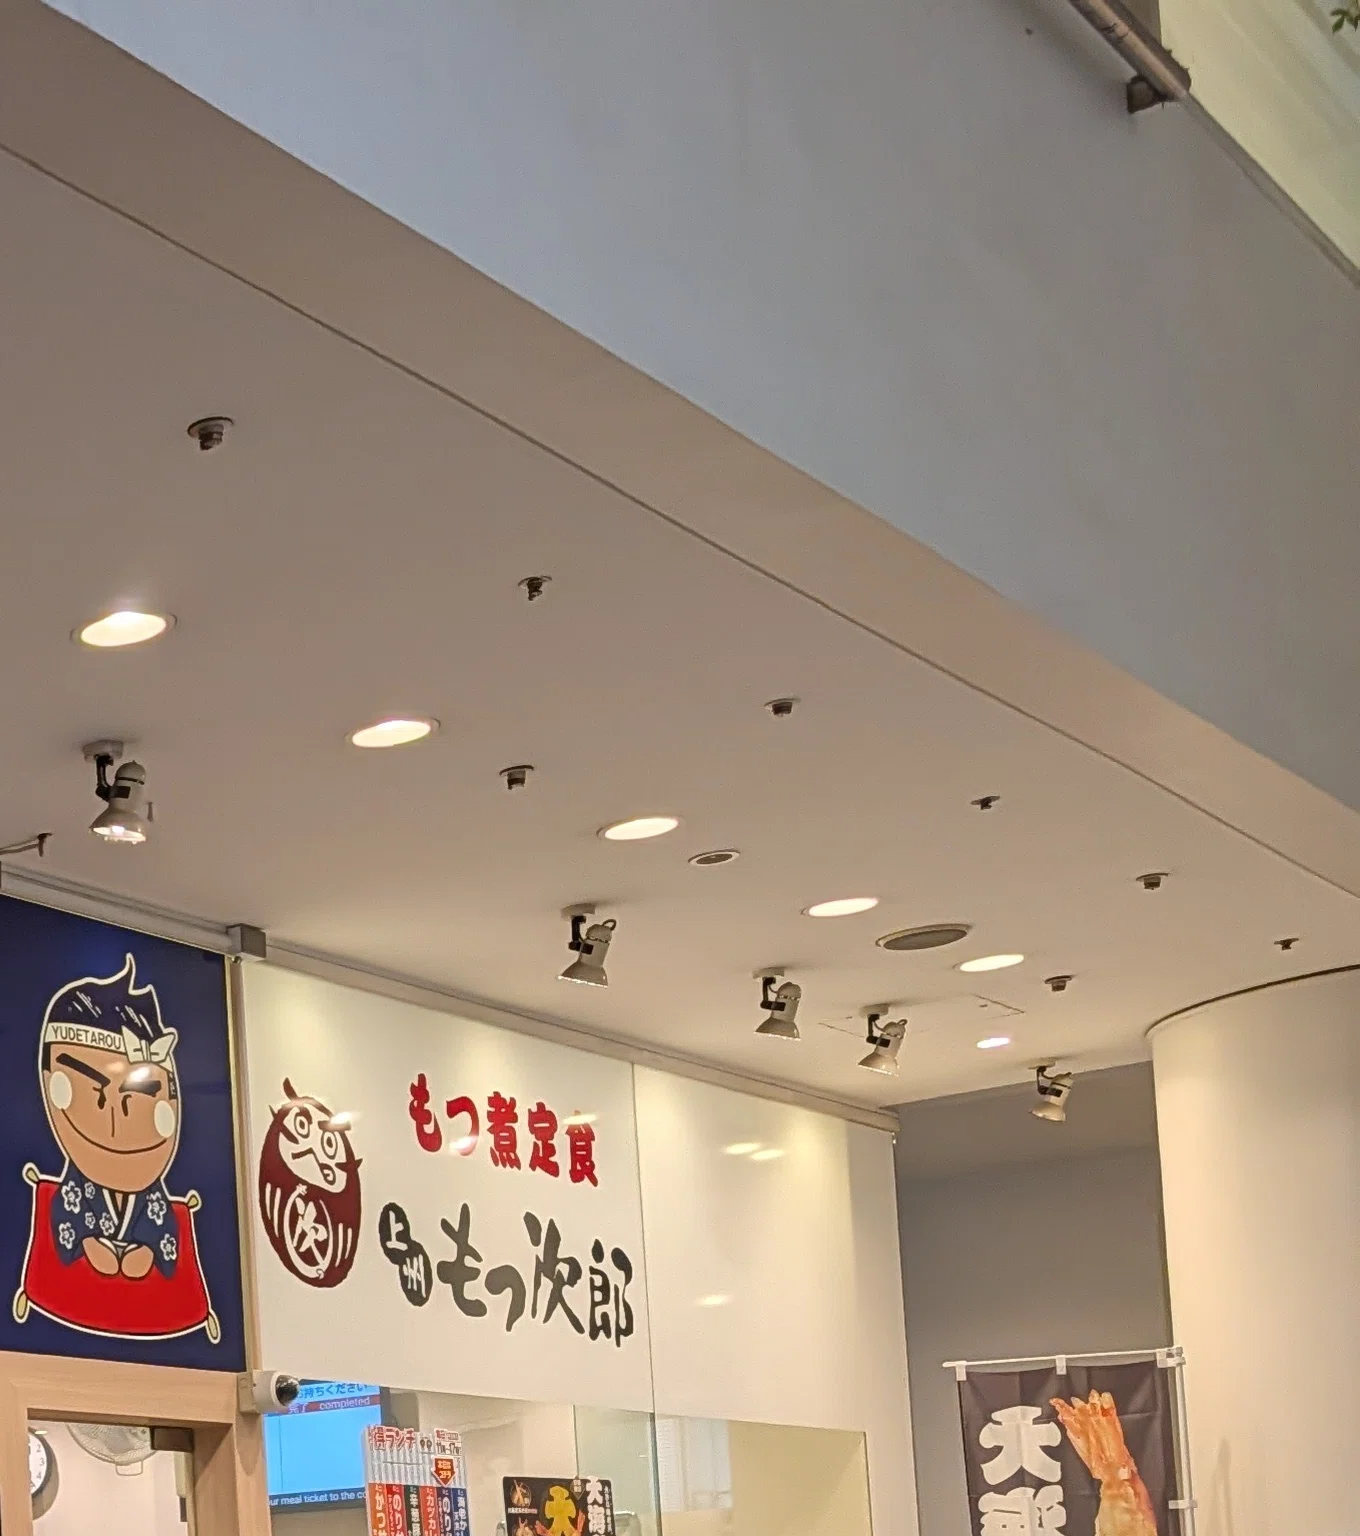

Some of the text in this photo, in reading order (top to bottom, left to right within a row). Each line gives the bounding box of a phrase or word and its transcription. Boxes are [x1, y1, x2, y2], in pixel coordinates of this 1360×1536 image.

[50, 1024, 123, 1050] YUDETAROU
[409, 1073, 598, 1187] もつ煮定食
[436, 1202, 634, 1347] もつ次郎
[320, 1396, 371, 1411] completed
[281, 1494, 302, 1505] meal
[305, 1493, 328, 1503] ticket
[330, 1492, 339, 1501] to
[341, 1491, 355, 1500] the
